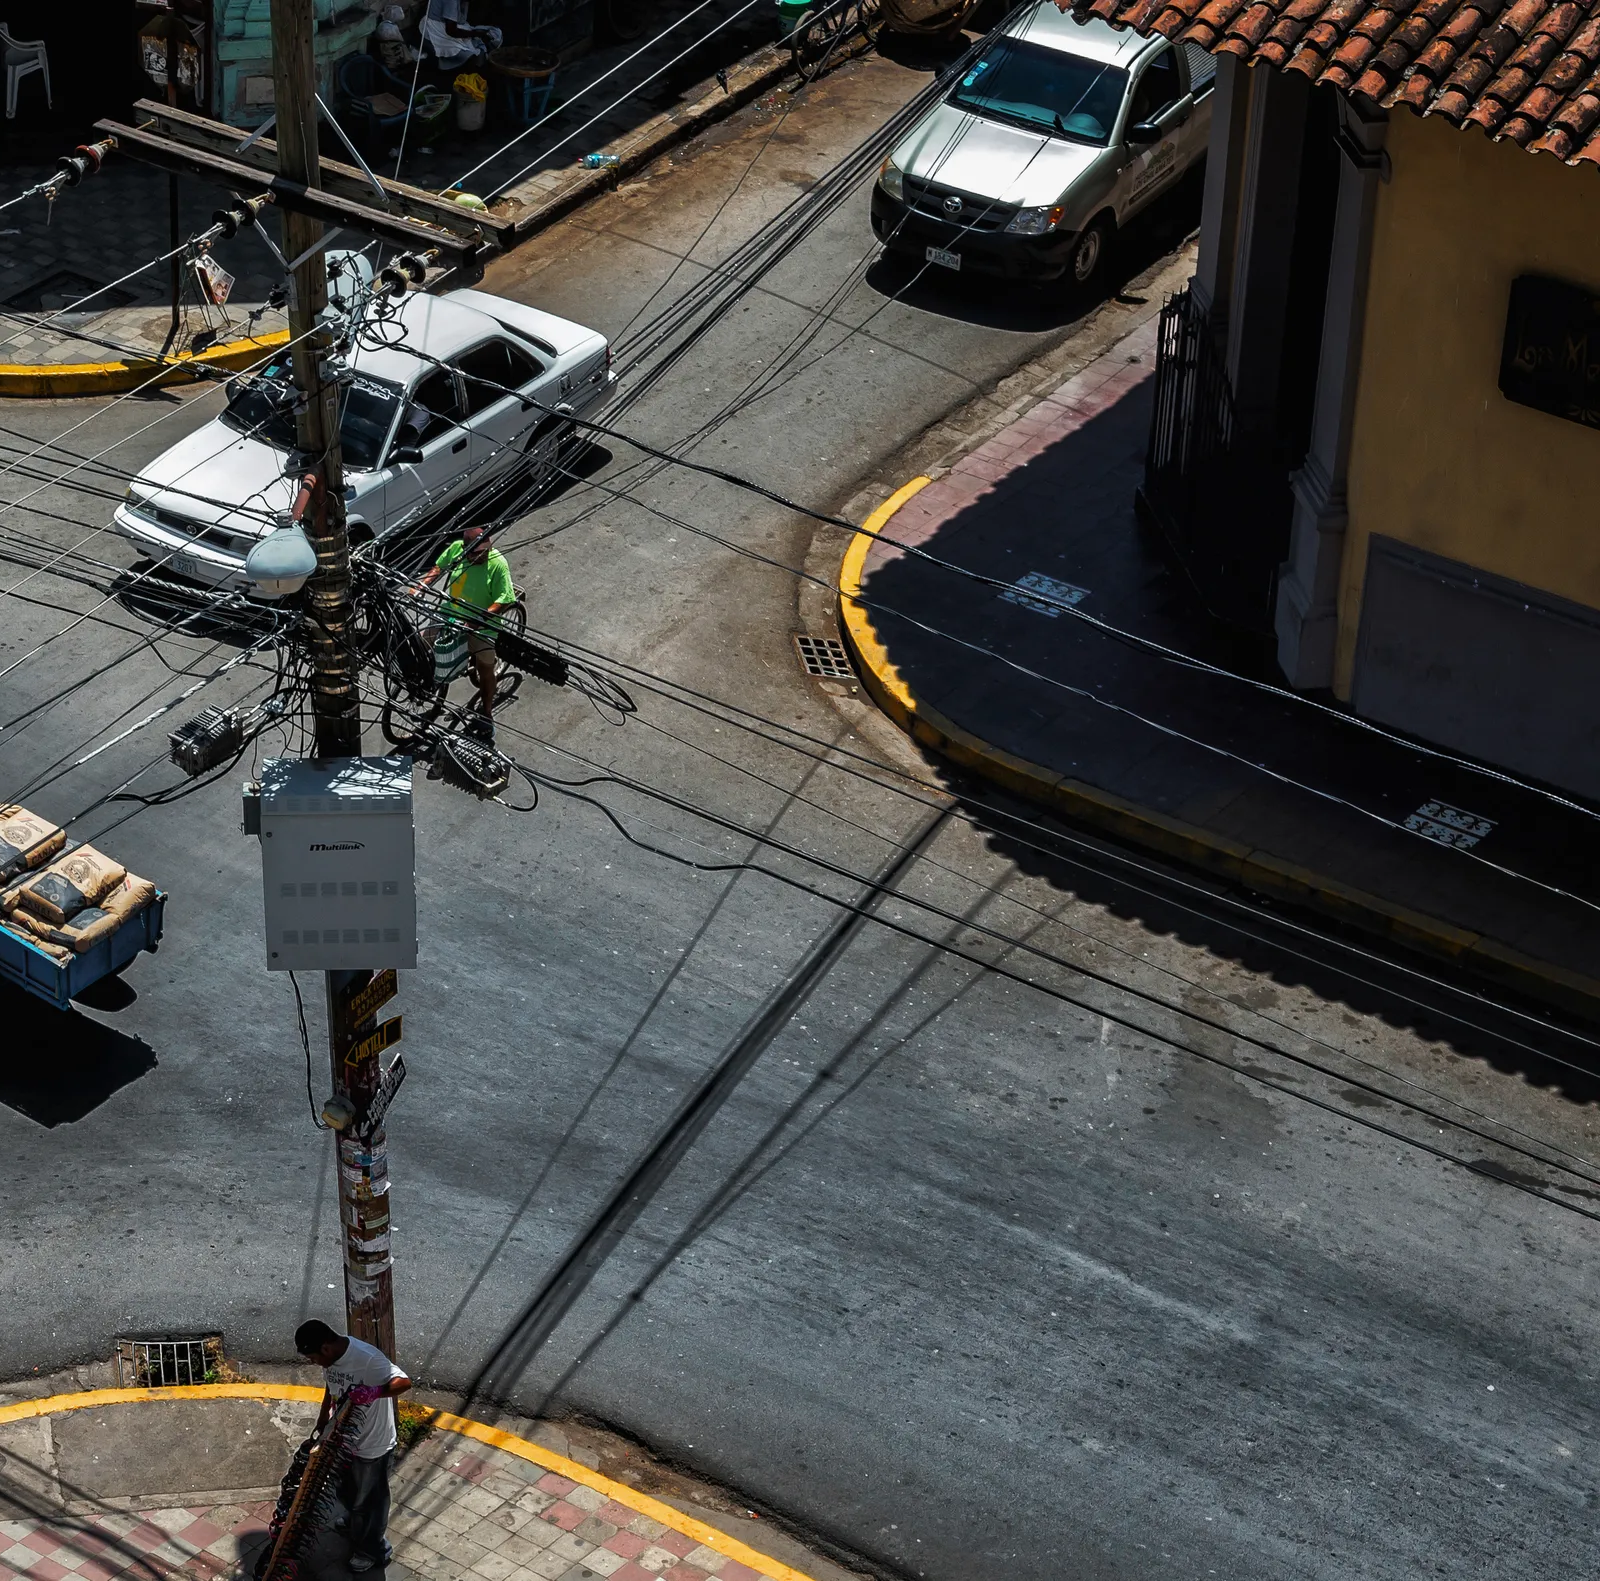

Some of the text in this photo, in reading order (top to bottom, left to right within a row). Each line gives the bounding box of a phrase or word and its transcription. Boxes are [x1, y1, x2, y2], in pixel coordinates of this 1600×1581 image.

[310, 842, 362, 851] Multilink
[351, 986, 373, 1011] ERICK
[373, 970, 395, 992] TOURS
[355, 1031, 384, 1064] HOSTEL
